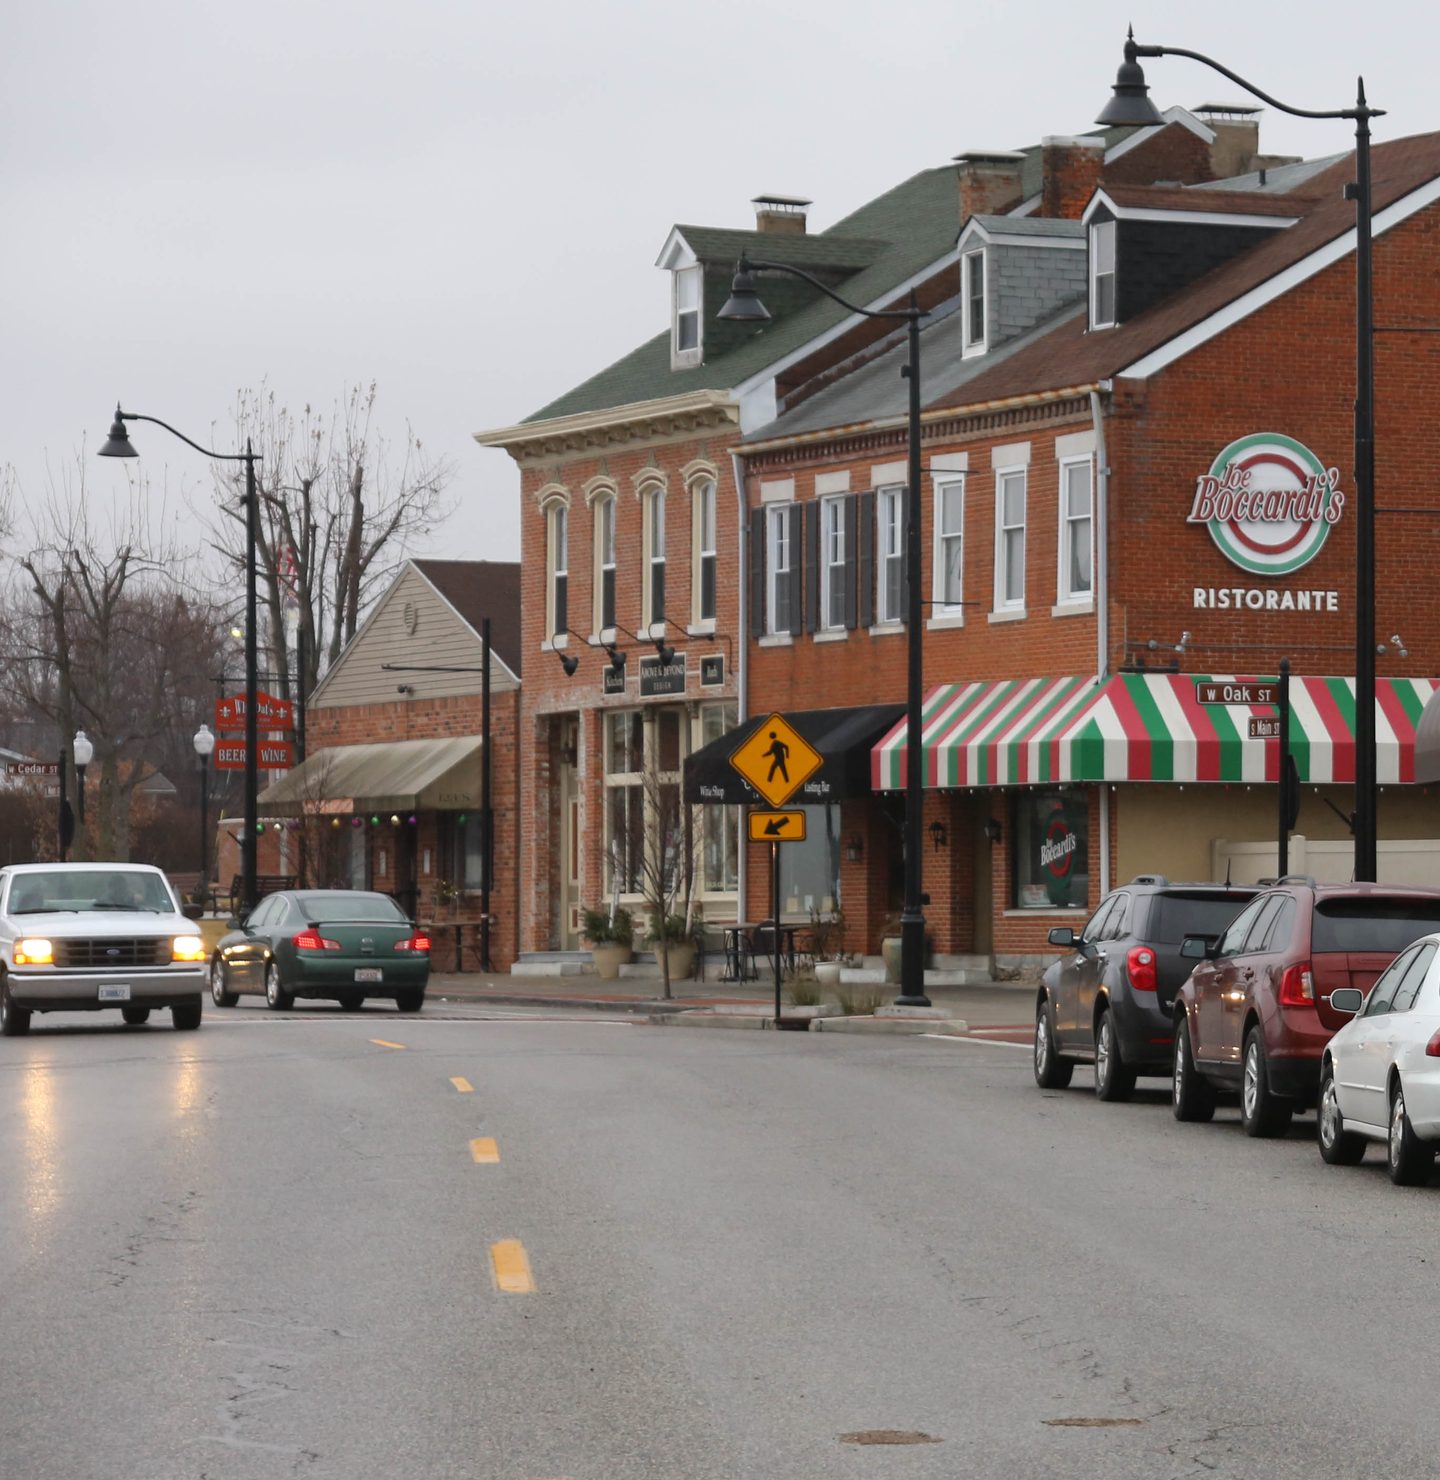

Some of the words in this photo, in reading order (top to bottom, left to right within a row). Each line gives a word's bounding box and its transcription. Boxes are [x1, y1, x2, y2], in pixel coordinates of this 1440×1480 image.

[1221, 463, 1251, 488] Joe
[1187, 467, 1344, 524] Boccardi's
[1193, 588, 1339, 612] RISTORANTE
[1223, 686, 1251, 701] Oak
[1258, 689, 1271, 701] ST
[1257, 720, 1272, 736] Main
[219, 748, 246, 762] BEER
[261, 748, 287, 763] WINE
[18, 764, 46, 774] Cedar
